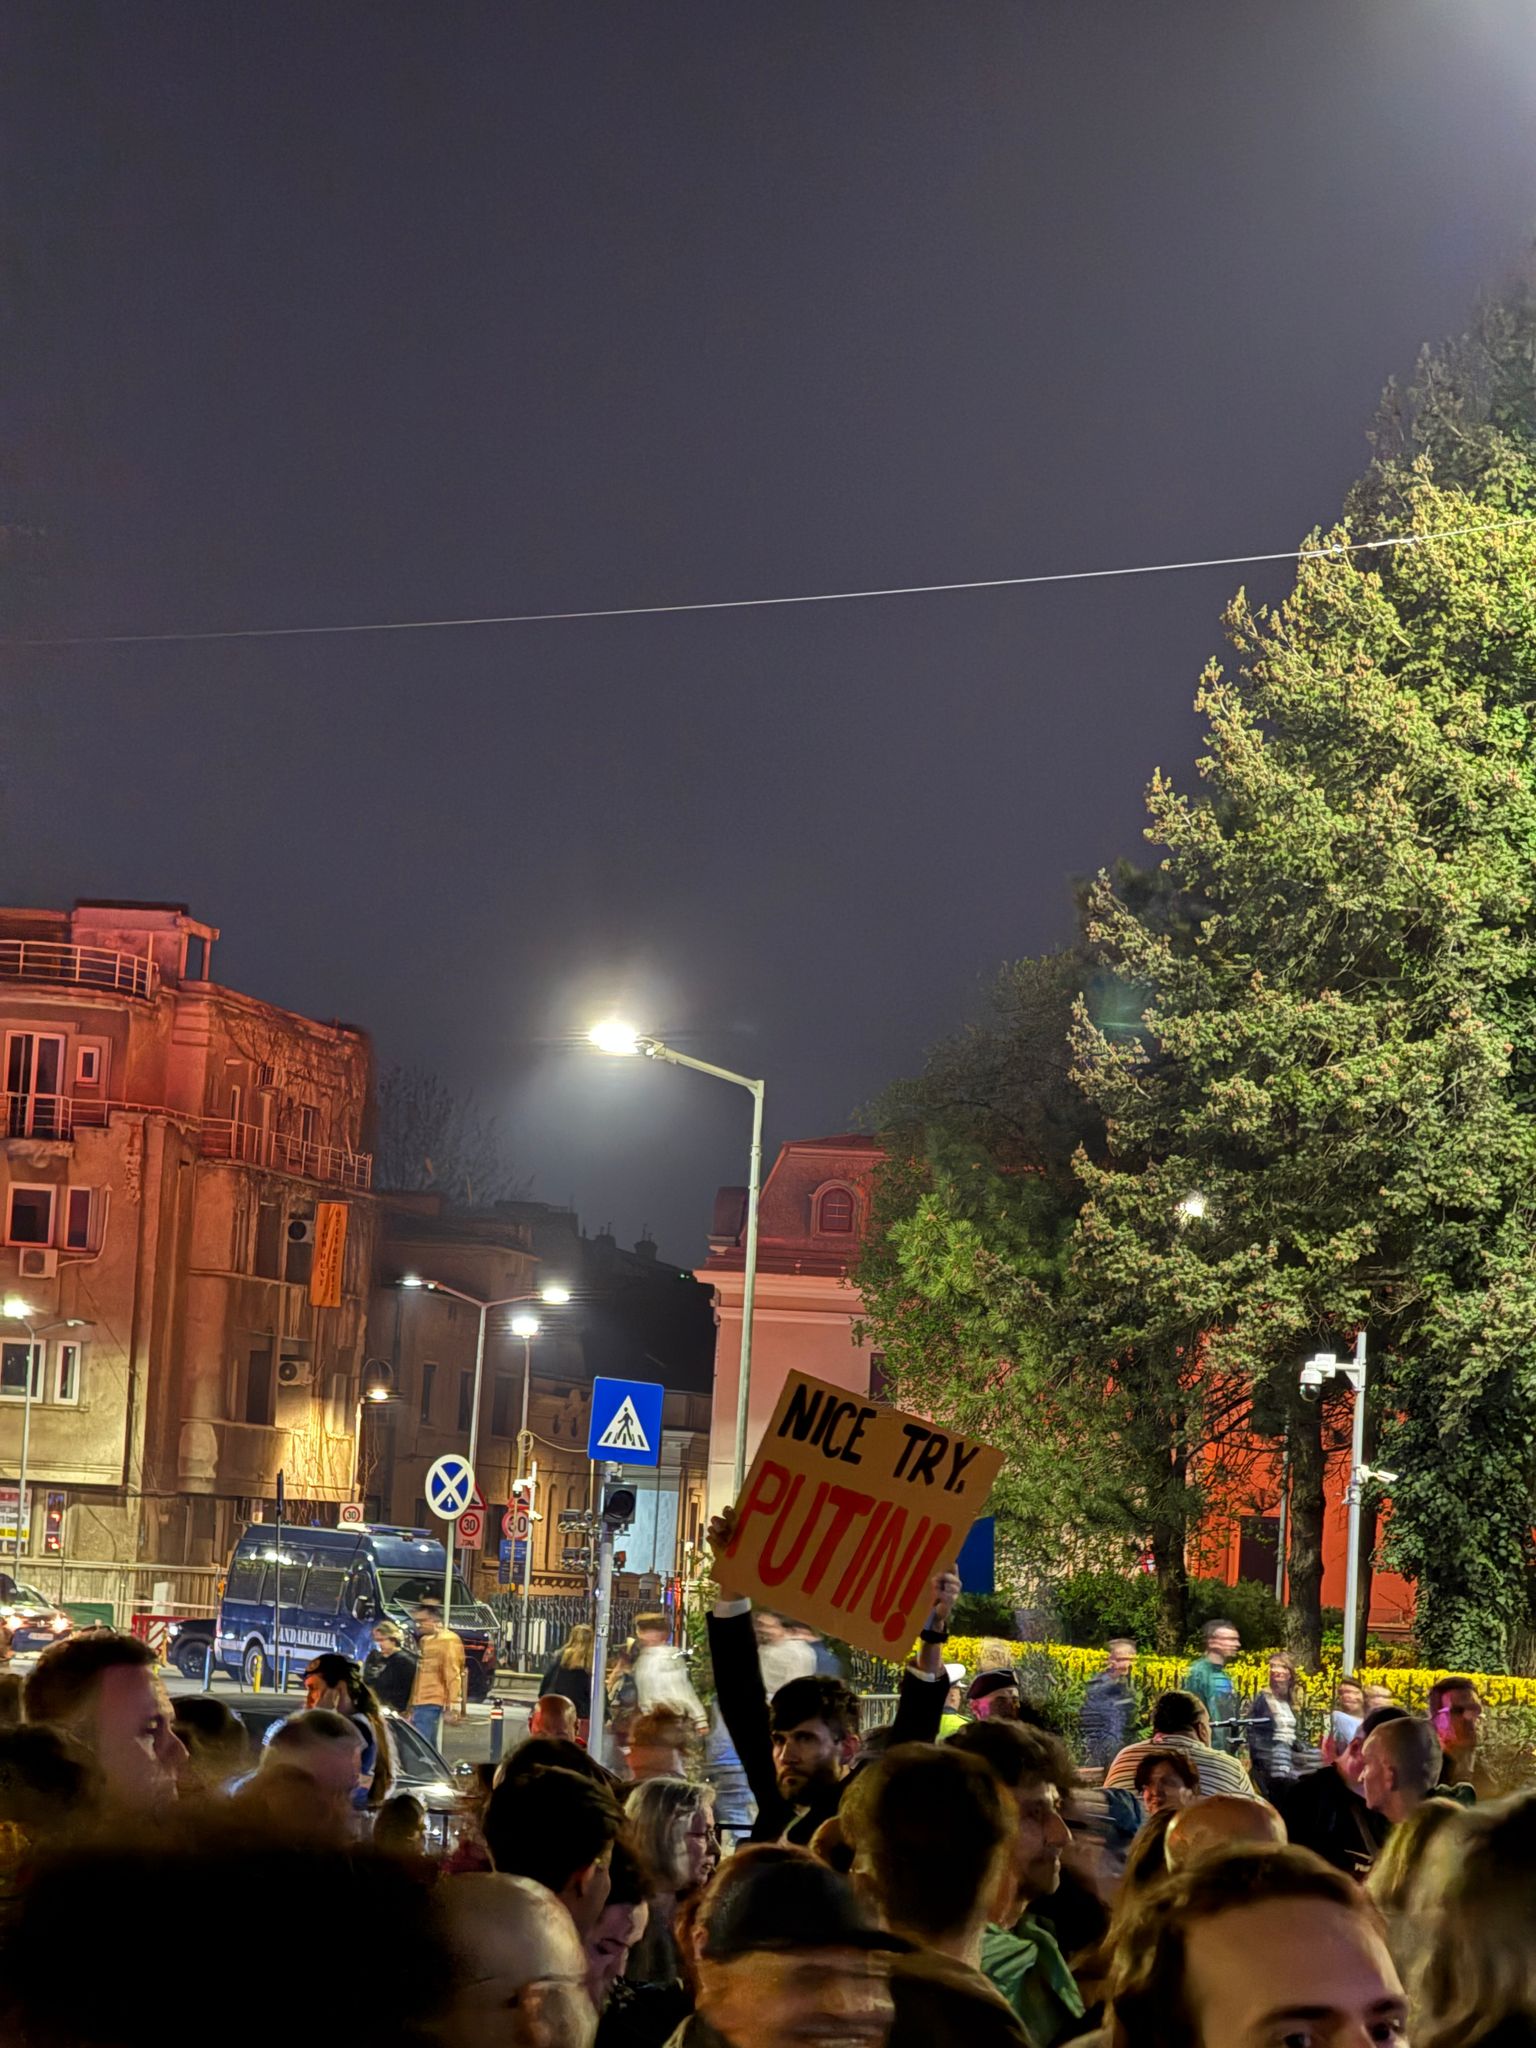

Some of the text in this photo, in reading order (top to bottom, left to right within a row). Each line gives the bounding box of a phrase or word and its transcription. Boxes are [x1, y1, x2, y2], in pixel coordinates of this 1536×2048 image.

[777, 1383, 979, 1494] NICE TRY,
[346, 1510, 357, 1520] 30
[463, 1518, 476, 1531] 30
[725, 1460, 952, 1642] PUTIN!
